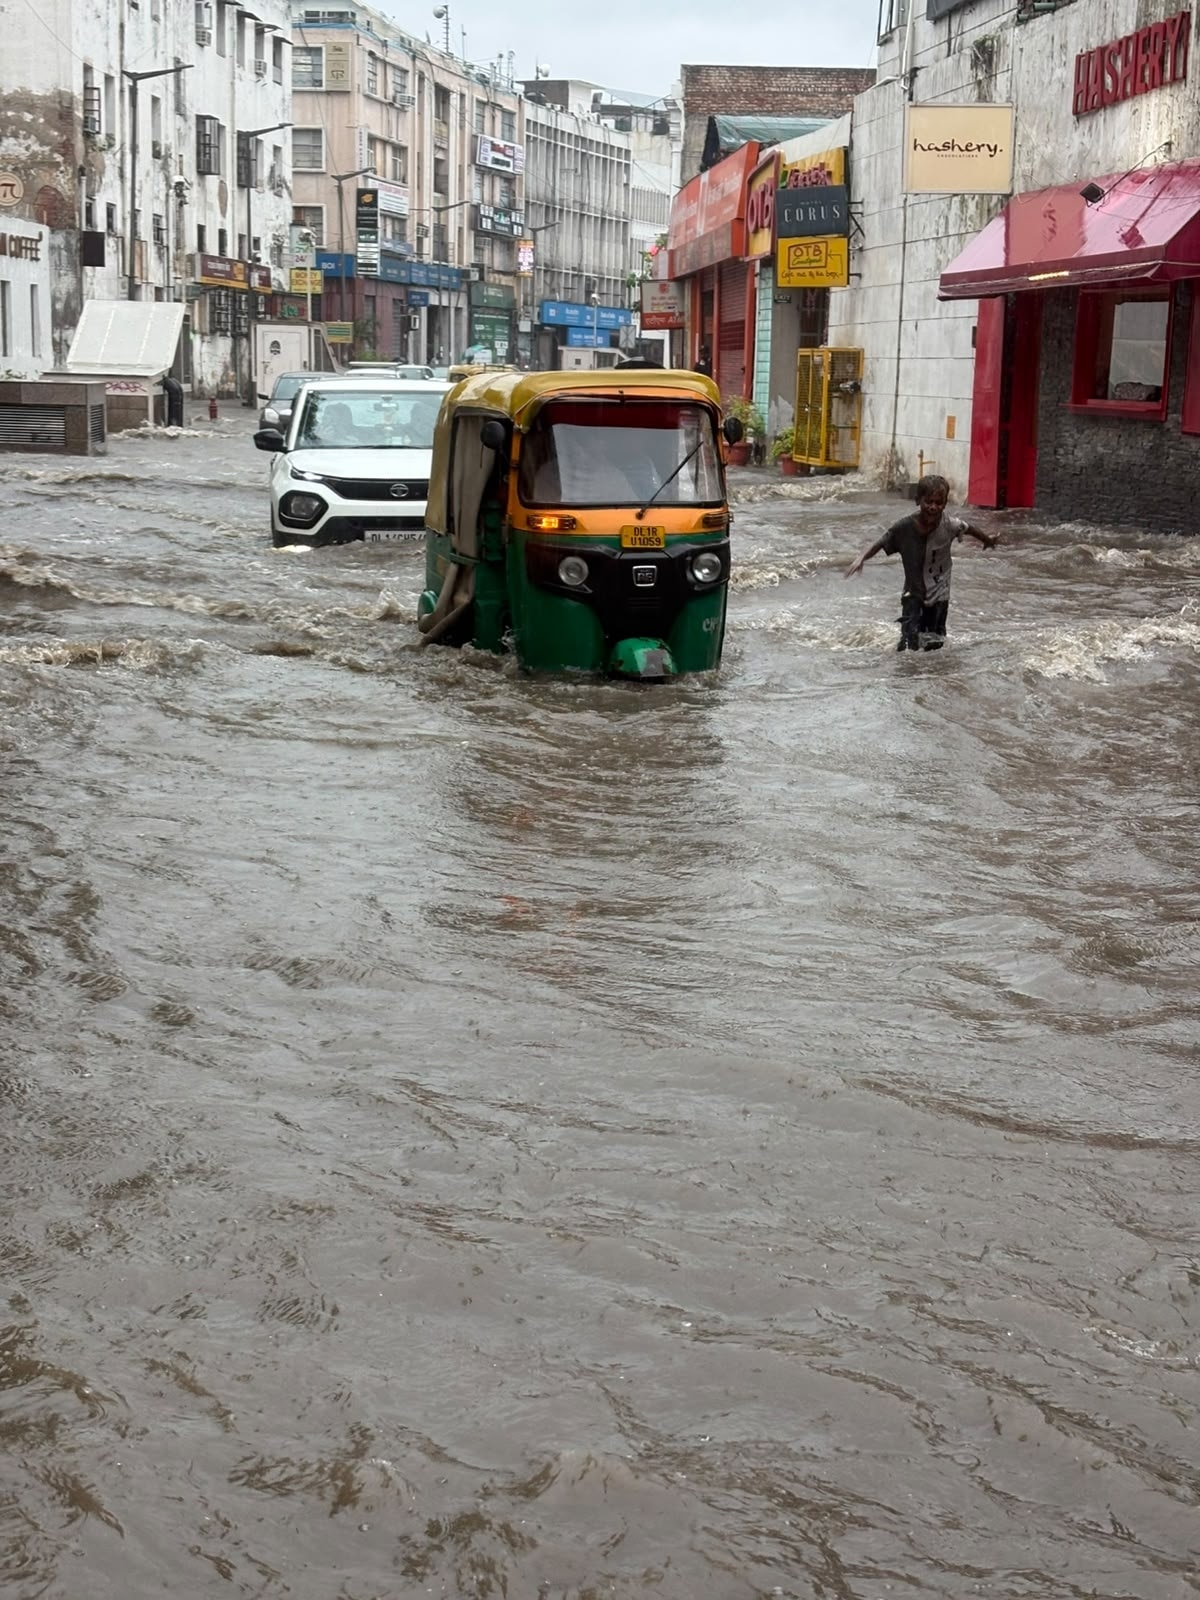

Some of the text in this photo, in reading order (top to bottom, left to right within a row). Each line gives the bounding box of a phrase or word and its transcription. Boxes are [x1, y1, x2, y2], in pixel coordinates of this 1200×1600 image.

[1072, 11, 1191, 117] HASHERY
[914, 138, 1004, 158] hashery.
[748, 178, 776, 234] OTB
[784, 204, 840, 223] CORUS
[9, 233, 42, 262] COFFEE
[793, 244, 822, 258] OTB
[630, 537, 662, 548] U1059
